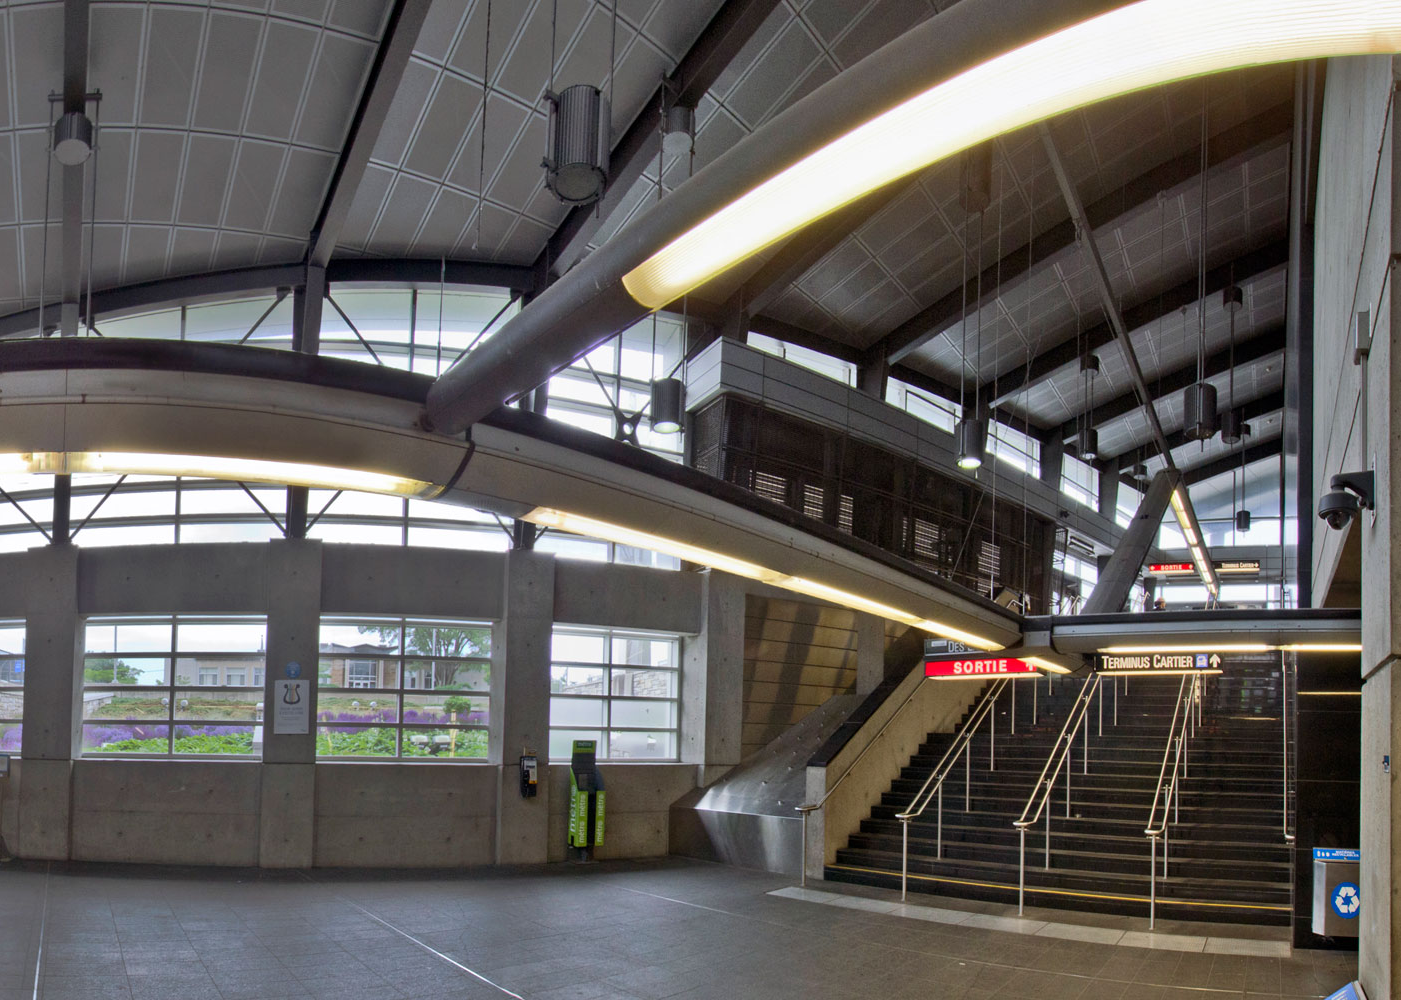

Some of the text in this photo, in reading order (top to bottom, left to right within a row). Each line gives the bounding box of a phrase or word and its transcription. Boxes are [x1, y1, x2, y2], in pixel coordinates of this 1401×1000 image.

[949, 641, 965, 653] DES
[953, 660, 1008, 674] SORTIE
[1101, 654, 1194, 669] TERMINUS CARTIER
